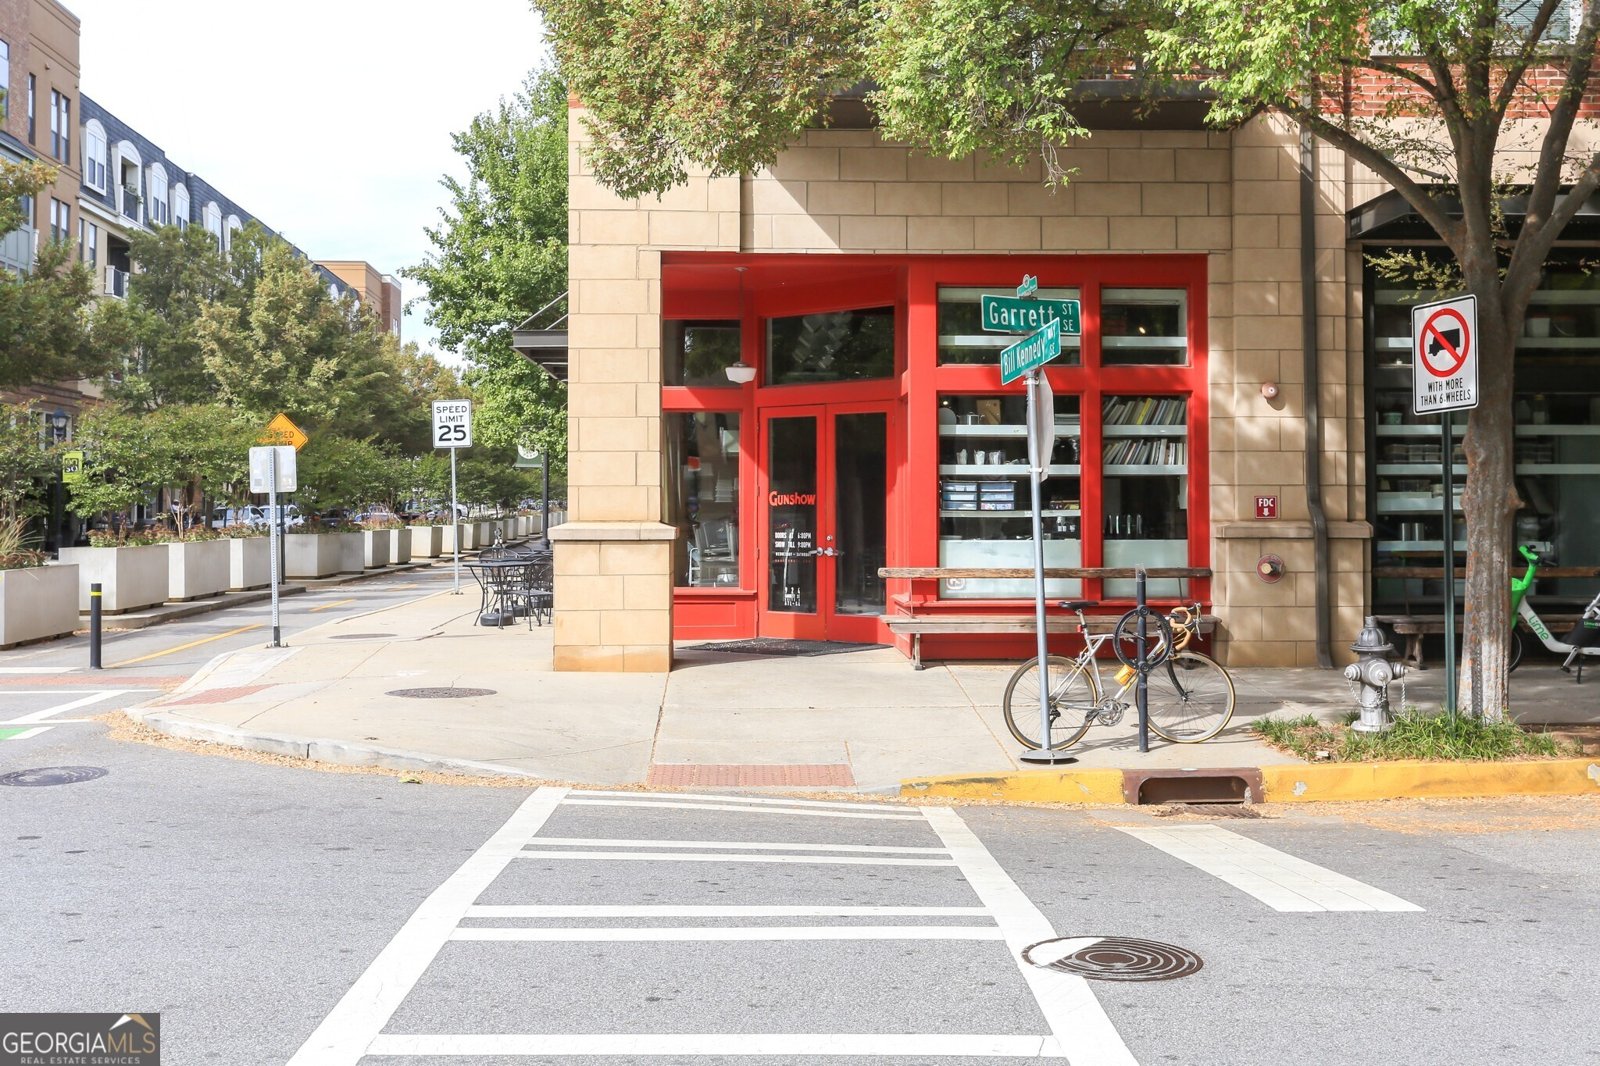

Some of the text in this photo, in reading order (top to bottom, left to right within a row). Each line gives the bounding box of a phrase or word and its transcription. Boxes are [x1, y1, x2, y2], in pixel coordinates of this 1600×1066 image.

[989, 302, 1073, 327] Garrett ST
[1062, 319, 1074, 332] SE
[1003, 348, 1016, 376] Bill
[1016, 335, 1046, 369] Kennedy
[1427, 377, 1463, 393] WITH MORE
[1420, 394, 1437, 407] THAN
[1445, 389, 1471, 403] WHEELS
[436, 405, 468, 414] SPEED
[439, 415, 464, 423] LIMIT
[438, 424, 467, 442] 25
[1258, 498, 1274, 507] FDC
[1528, 615, 1550, 641] Lime
